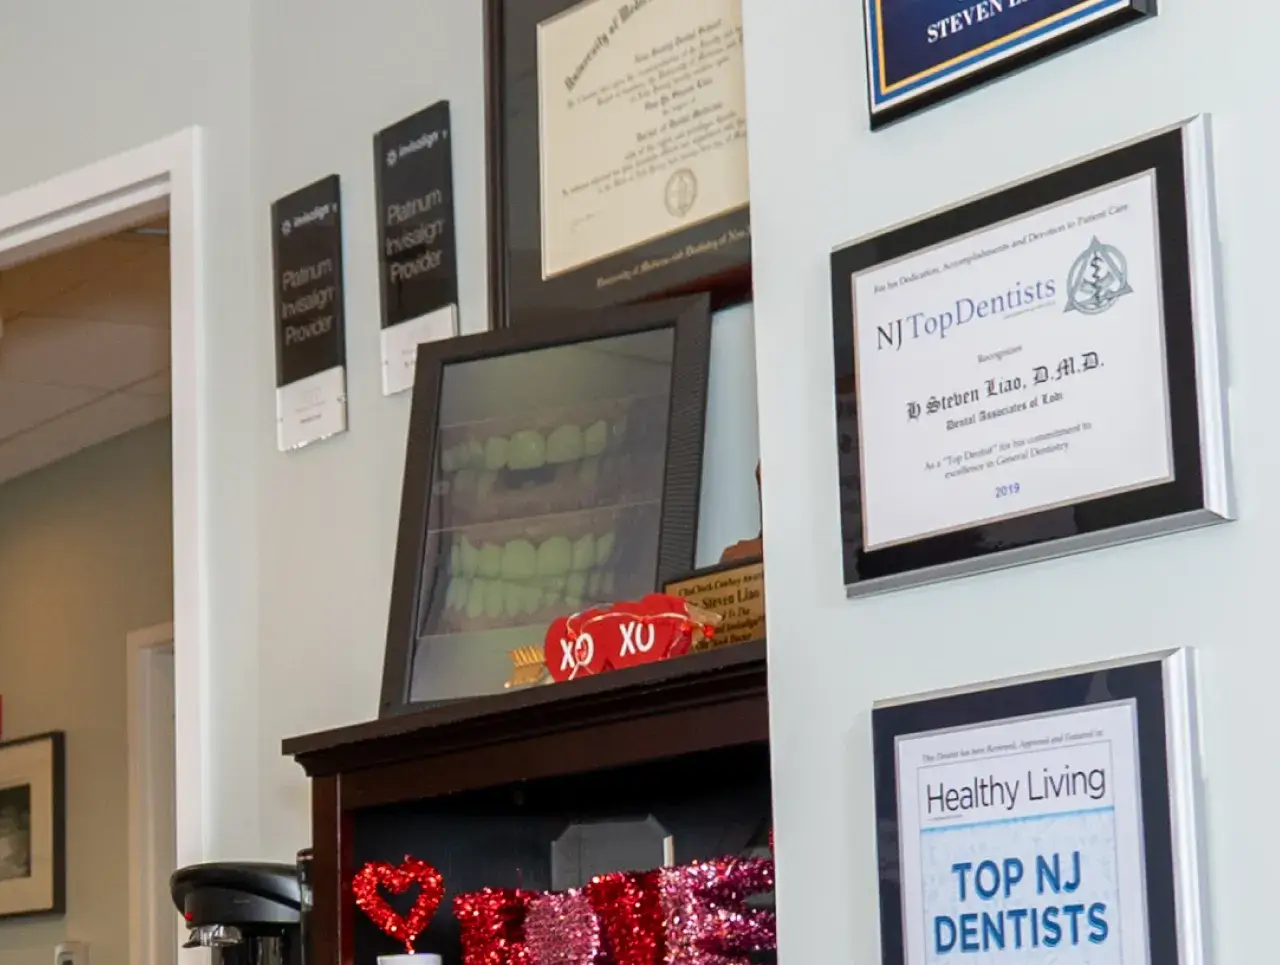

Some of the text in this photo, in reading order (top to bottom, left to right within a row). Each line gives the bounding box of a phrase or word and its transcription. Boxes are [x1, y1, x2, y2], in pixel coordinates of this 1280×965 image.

[927, 0, 1003, 43] STEVEN
[926, 387, 979, 415] Steven
[984, 377, 1027, 398] Liao,
[1032, 351, 1105, 385] D.M.D.
[995, 482, 1020, 499] 2019
[926, 764, 1106, 815] Healthy Living
[951, 850, 1082, 903] TOP NJ
[933, 902, 1110, 955] DENTISTS
